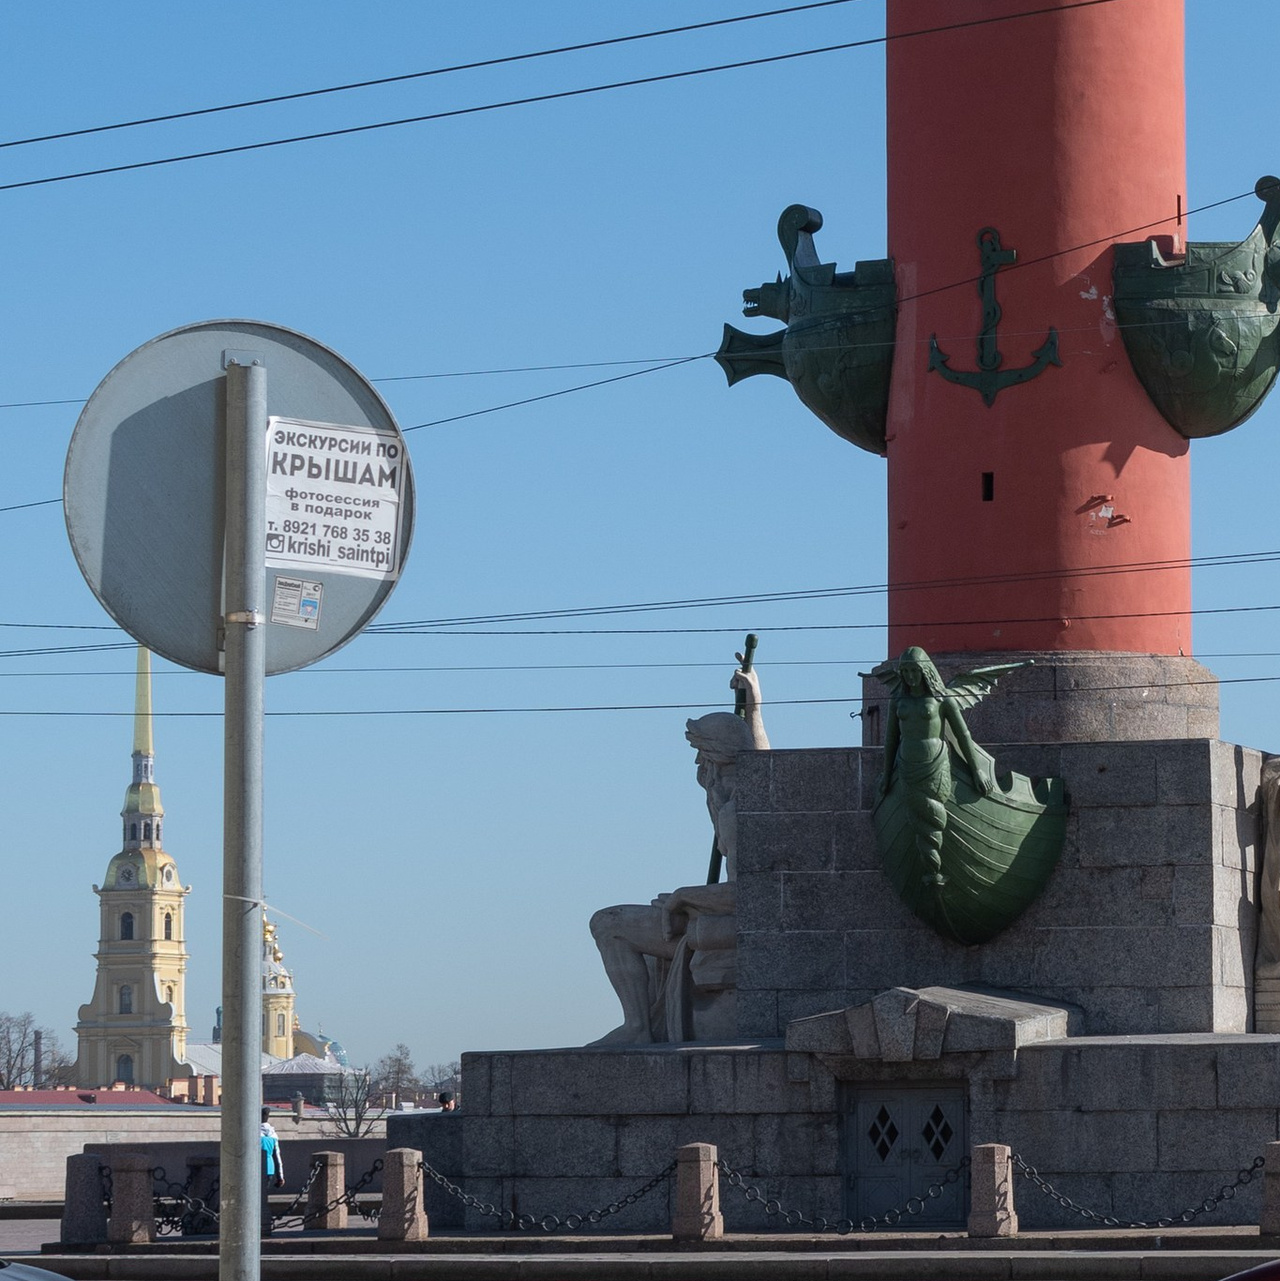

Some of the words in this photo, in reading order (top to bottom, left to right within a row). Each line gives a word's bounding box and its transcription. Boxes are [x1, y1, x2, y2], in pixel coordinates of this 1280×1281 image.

[274, 430, 371, 455] ЭКСКУРСИИ
[376, 442, 399, 459] ПО
[271, 451, 397, 489] КРЫШАМ
[285, 487, 380, 508] фотосессия
[291, 502, 299, 511] в
[305, 504, 372, 520] подарок
[268, 520, 278, 531] т.
[283, 519, 316, 535] 8921
[323, 524, 348, 540] 768
[353, 527, 370, 543] 35
[374, 530, 391, 545] 38
[287, 535, 390, 568] krishi_saintpi
